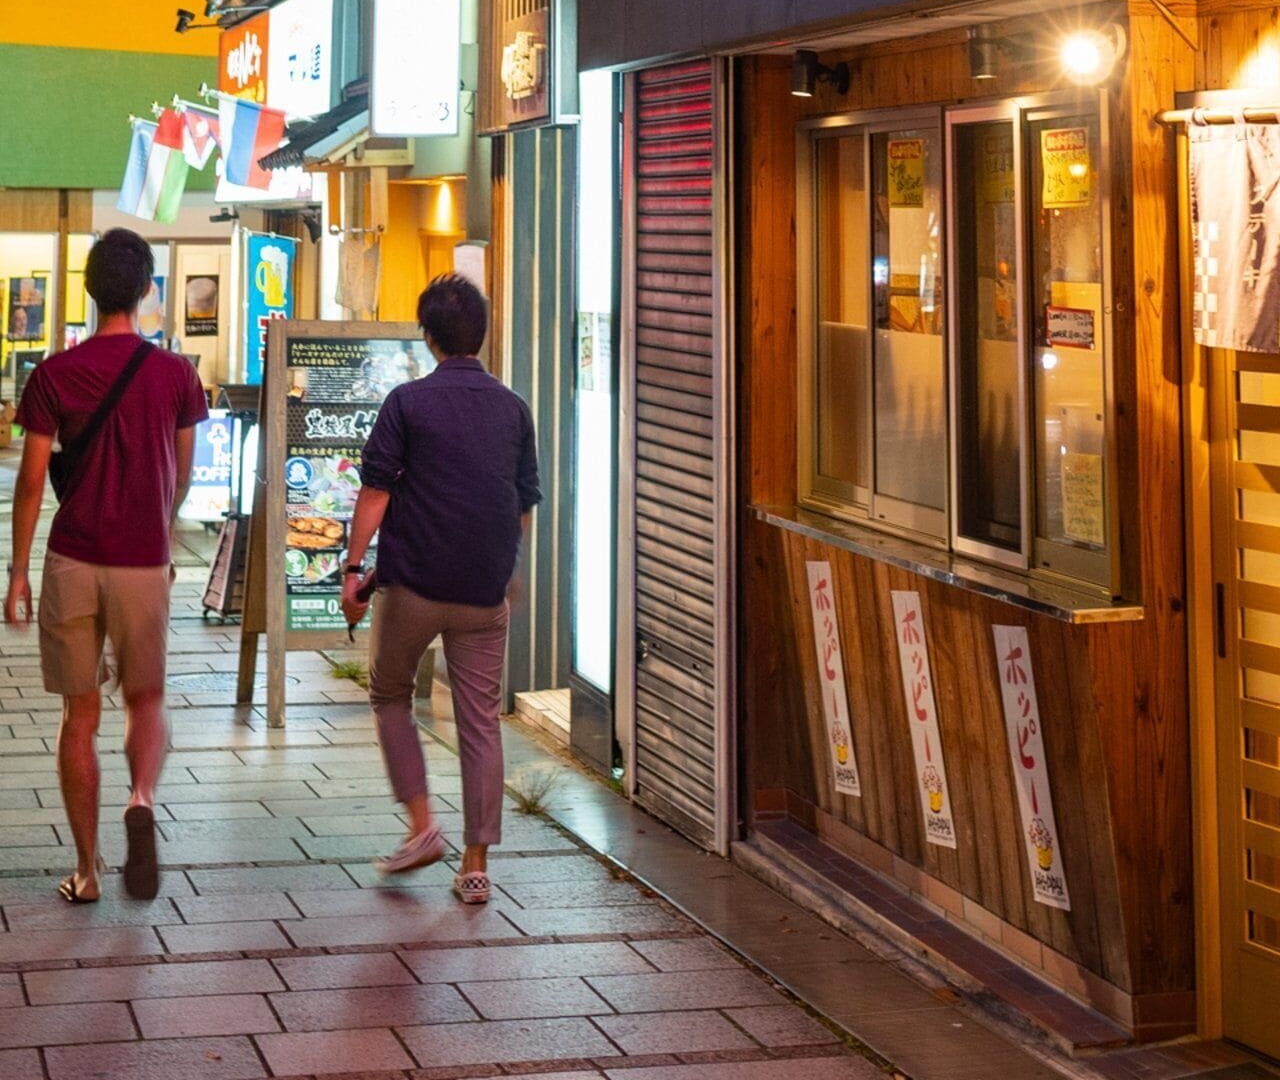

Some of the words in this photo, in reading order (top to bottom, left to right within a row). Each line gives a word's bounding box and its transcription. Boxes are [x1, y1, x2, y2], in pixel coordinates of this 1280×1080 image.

[1243, 183, 1266, 289] ステーキ
[814, 575, 839, 719] ホッピー
[903, 603, 931, 763] ホッピー
[1005, 640, 1040, 816] ホッピー
